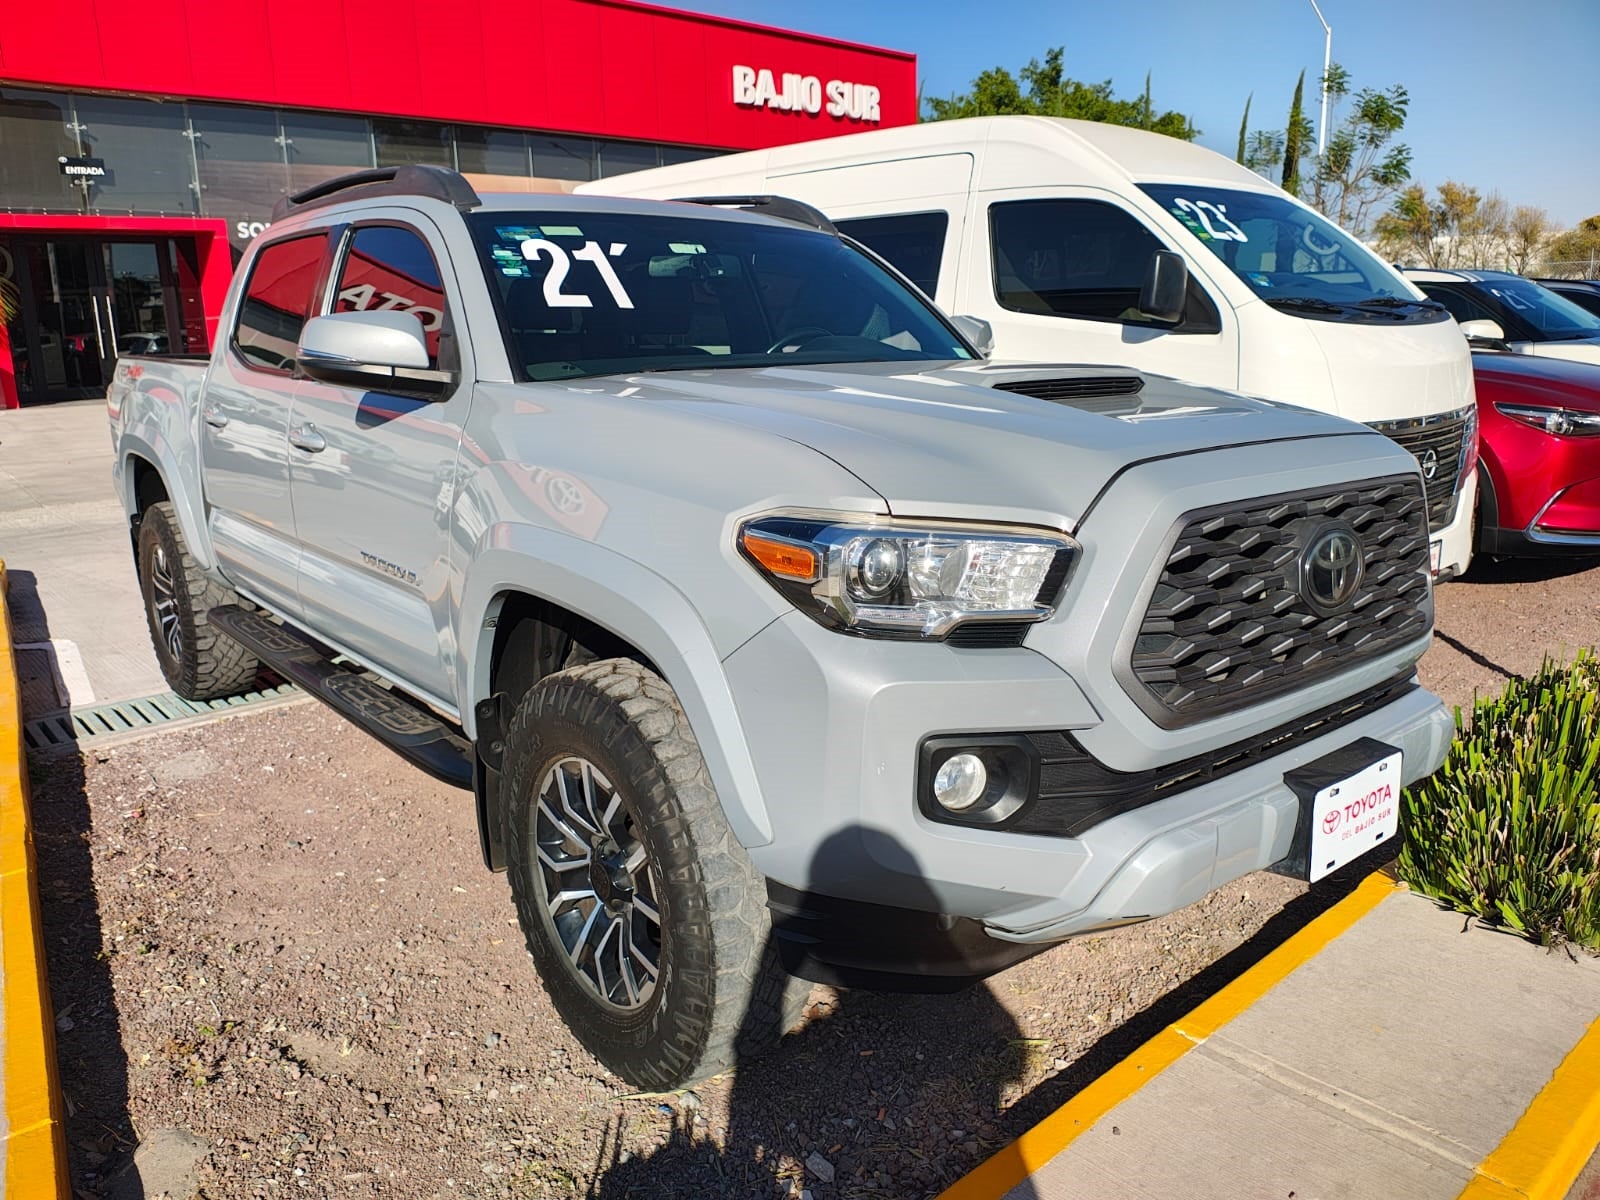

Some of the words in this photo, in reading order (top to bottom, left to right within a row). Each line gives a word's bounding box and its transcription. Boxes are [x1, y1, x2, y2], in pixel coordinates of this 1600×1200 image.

[732, 65, 821, 113] BAJIO
[826, 79, 880, 121] SUR
[64, 165, 105, 176] ENTRADA
[236, 221, 271, 239] SO
[1344, 783, 1392, 823] TOYOTA
[1341, 829, 1352, 841] DEL
[1378, 807, 1391, 822] SUR
